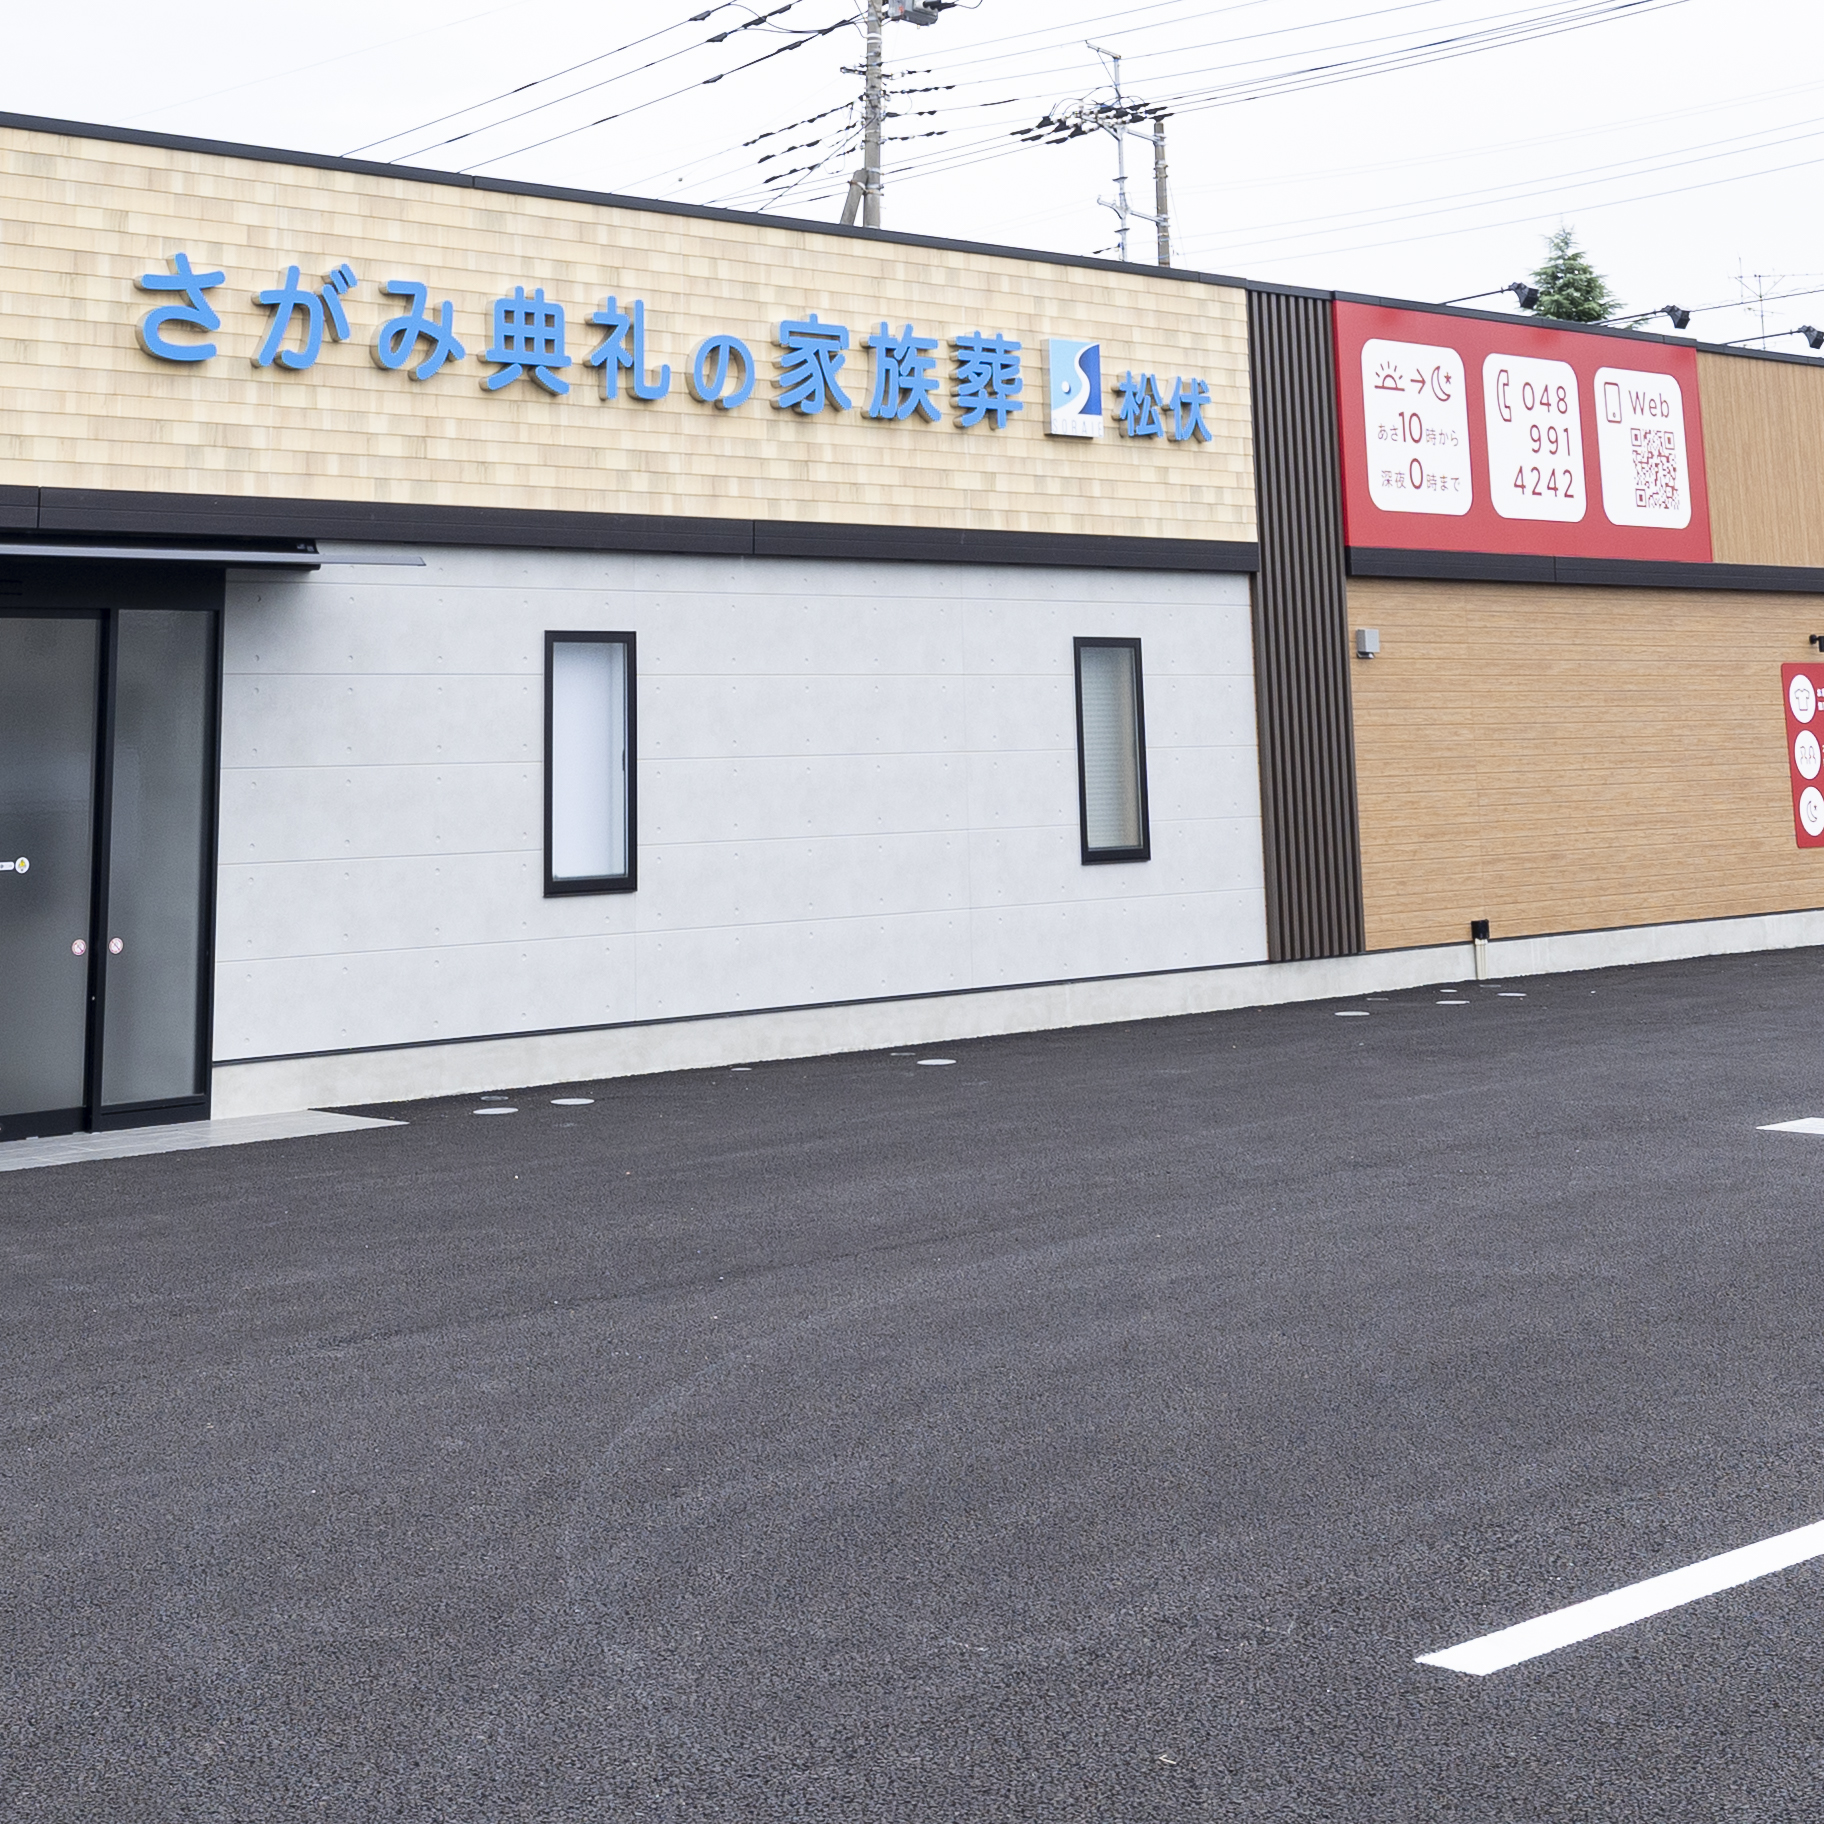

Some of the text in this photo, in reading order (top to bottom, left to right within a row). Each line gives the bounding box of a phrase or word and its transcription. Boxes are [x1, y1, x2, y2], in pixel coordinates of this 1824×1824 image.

[140, 252, 1024, 429] さがみ典礼の家族葬
[1118, 369, 1213, 442] 松伏
[1522, 381, 1568, 415] 048
[1627, 389, 1670, 419] Web
[1377, 411, 1459, 447] あさ10時から
[1529, 424, 1571, 456] 991
[1381, 458, 1460, 492] 深夜0時まで
[1513, 465, 1575, 499] 4242
